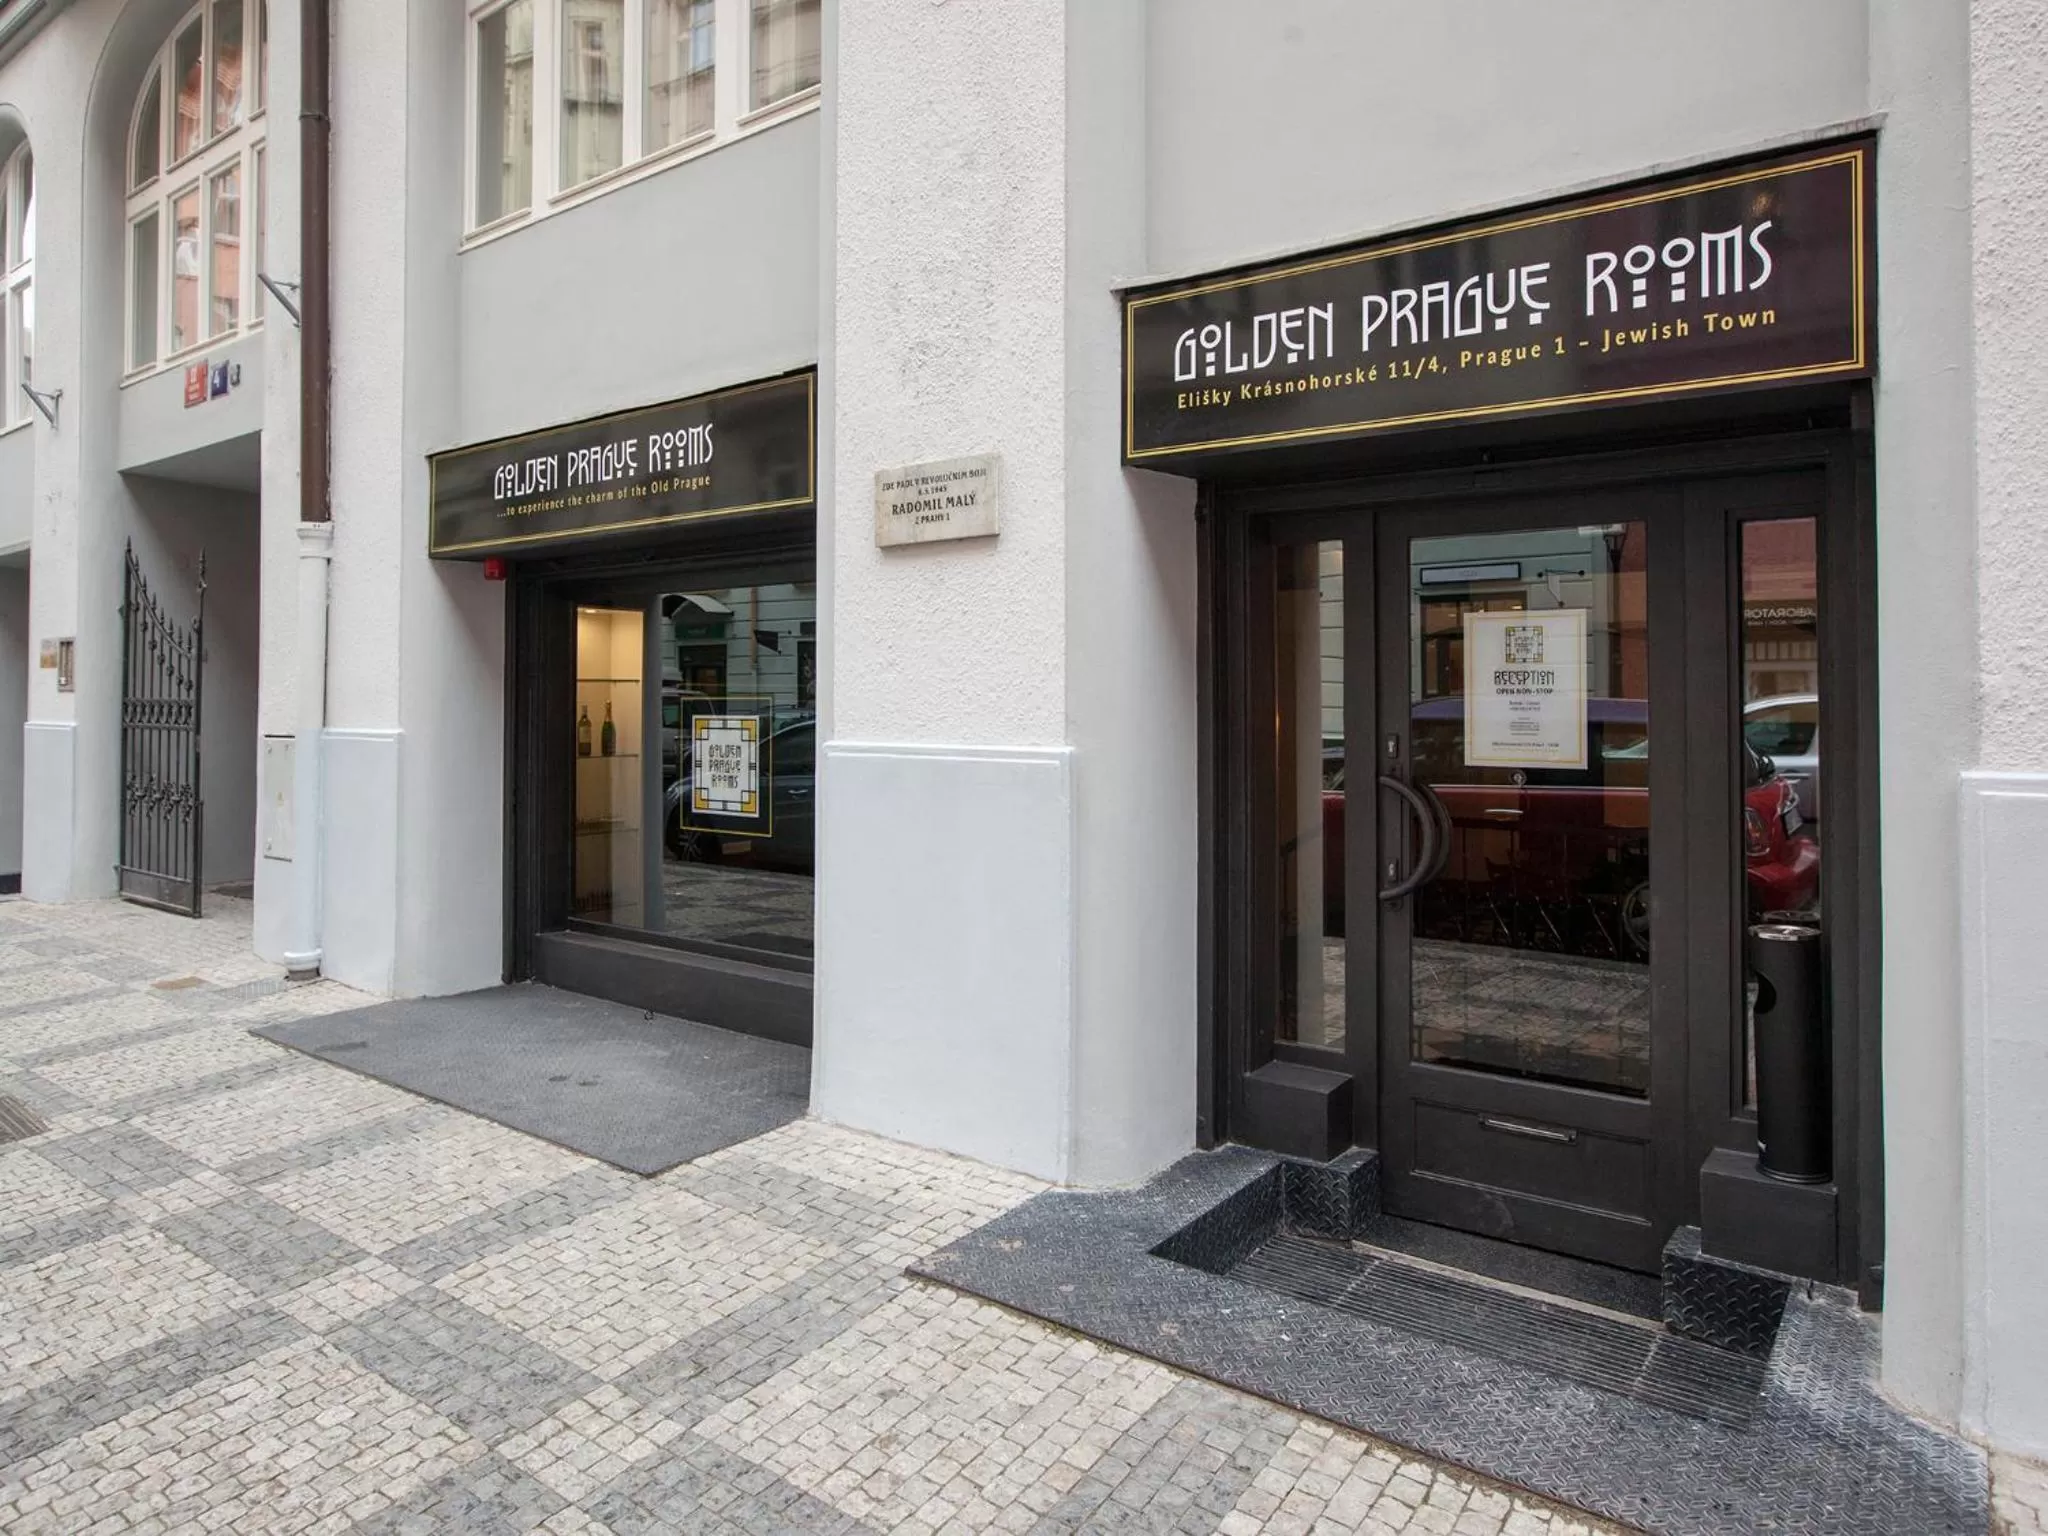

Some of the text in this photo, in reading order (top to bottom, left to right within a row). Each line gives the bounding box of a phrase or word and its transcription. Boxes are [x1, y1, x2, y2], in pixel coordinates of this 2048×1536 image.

[1174, 220, 1773, 382] GOLDEN PRAGUE ROOMS
[1177, 387, 1232, 409] Elišky
[1240, 365, 1378, 399] Krásnohorské
[1388, 356, 1449, 379] 11/4,
[1460, 345, 1541, 369] Prague
[1555, 335, 1566, 355] 1
[1601, 318, 1690, 354] Jewish
[1703, 309, 1776, 332] Town
[494, 423, 714, 500] GOLDEN PRAGUE ROOMS
[518, 499, 565, 516] experience
[567, 494, 583, 507] the
[586, 489, 615, 504] charm
[617, 487, 628, 500] of
[631, 484, 647, 497] the
[650, 479, 669, 494] Old
[674, 475, 711, 491] Prague
[892, 490, 976, 516] RADOMIL MALÝ
[1494, 670, 1555, 685] RECEPTION
[1496, 687, 1515, 695] OPEN
[709, 744, 741, 758] GOLDEN
[709, 759, 741, 773] PRAGUE
[712, 775, 738, 788] ROOMS
